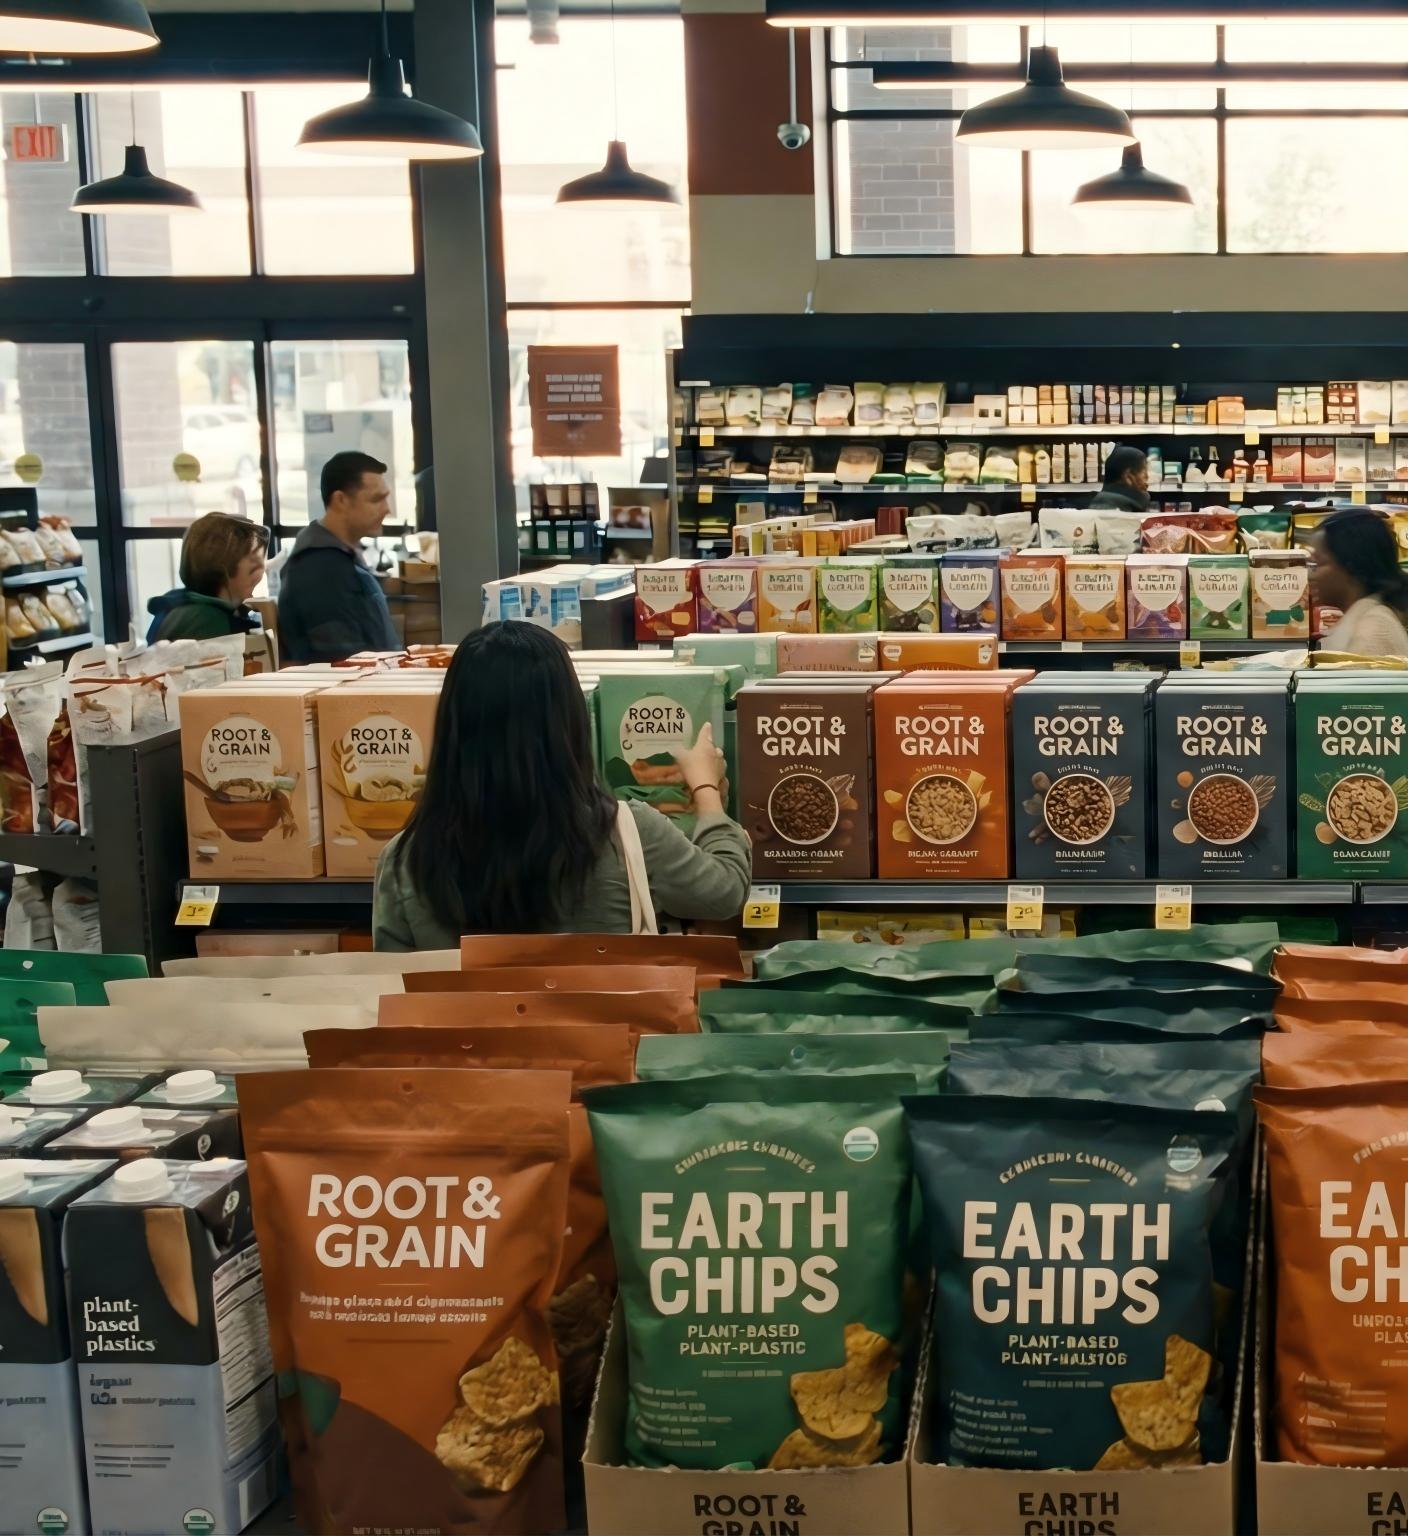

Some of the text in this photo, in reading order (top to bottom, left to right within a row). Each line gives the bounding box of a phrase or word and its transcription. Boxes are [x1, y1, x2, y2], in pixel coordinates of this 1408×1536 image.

[629, 707, 686, 720] ROOT &
[211, 729, 271, 741] ROOT &
[350, 729, 412, 741] ROOT &
[634, 721, 684, 734] GRAIN
[757, 716, 847, 736] ROOT &
[895, 716, 985, 735] ROOT &
[1034, 716, 1125, 735] ROOT &
[1176, 716, 1268, 736] ROOT &
[1317, 716, 1407, 735] ROOT &
[218, 743, 271, 756] GRAIN
[356, 743, 410, 756] GRAIN
[762, 737, 841, 756] GRAIN
[900, 737, 980, 756] GRAIN
[1038, 737, 1118, 756] GRAIN
[1182, 737, 1261, 756] GRAIN
[1321, 737, 1401, 756] GRAIN
[640, 1190, 849, 1250] EARTH
[963, 1200, 1171, 1261] EARTH
[315, 1223, 487, 1269] GRAIN
[649, 1255, 840, 1315] CHIPS
[972, 1266, 1160, 1325] CHIPS
[83, 1296, 139, 1319] plant-
[85, 1315, 140, 1332] based
[687, 1324, 800, 1339] PLANT-BASED
[86, 1334, 156, 1357] plastics
[679, 1342, 807, 1356] PLANT-PLASTIC
[693, 1494, 807, 1517] ROOT &
[1018, 1491, 1120, 1517] EARTH
[701, 1520, 801, 1536] GRAIN
[1024, 1519, 1116, 1536] CHIPS
